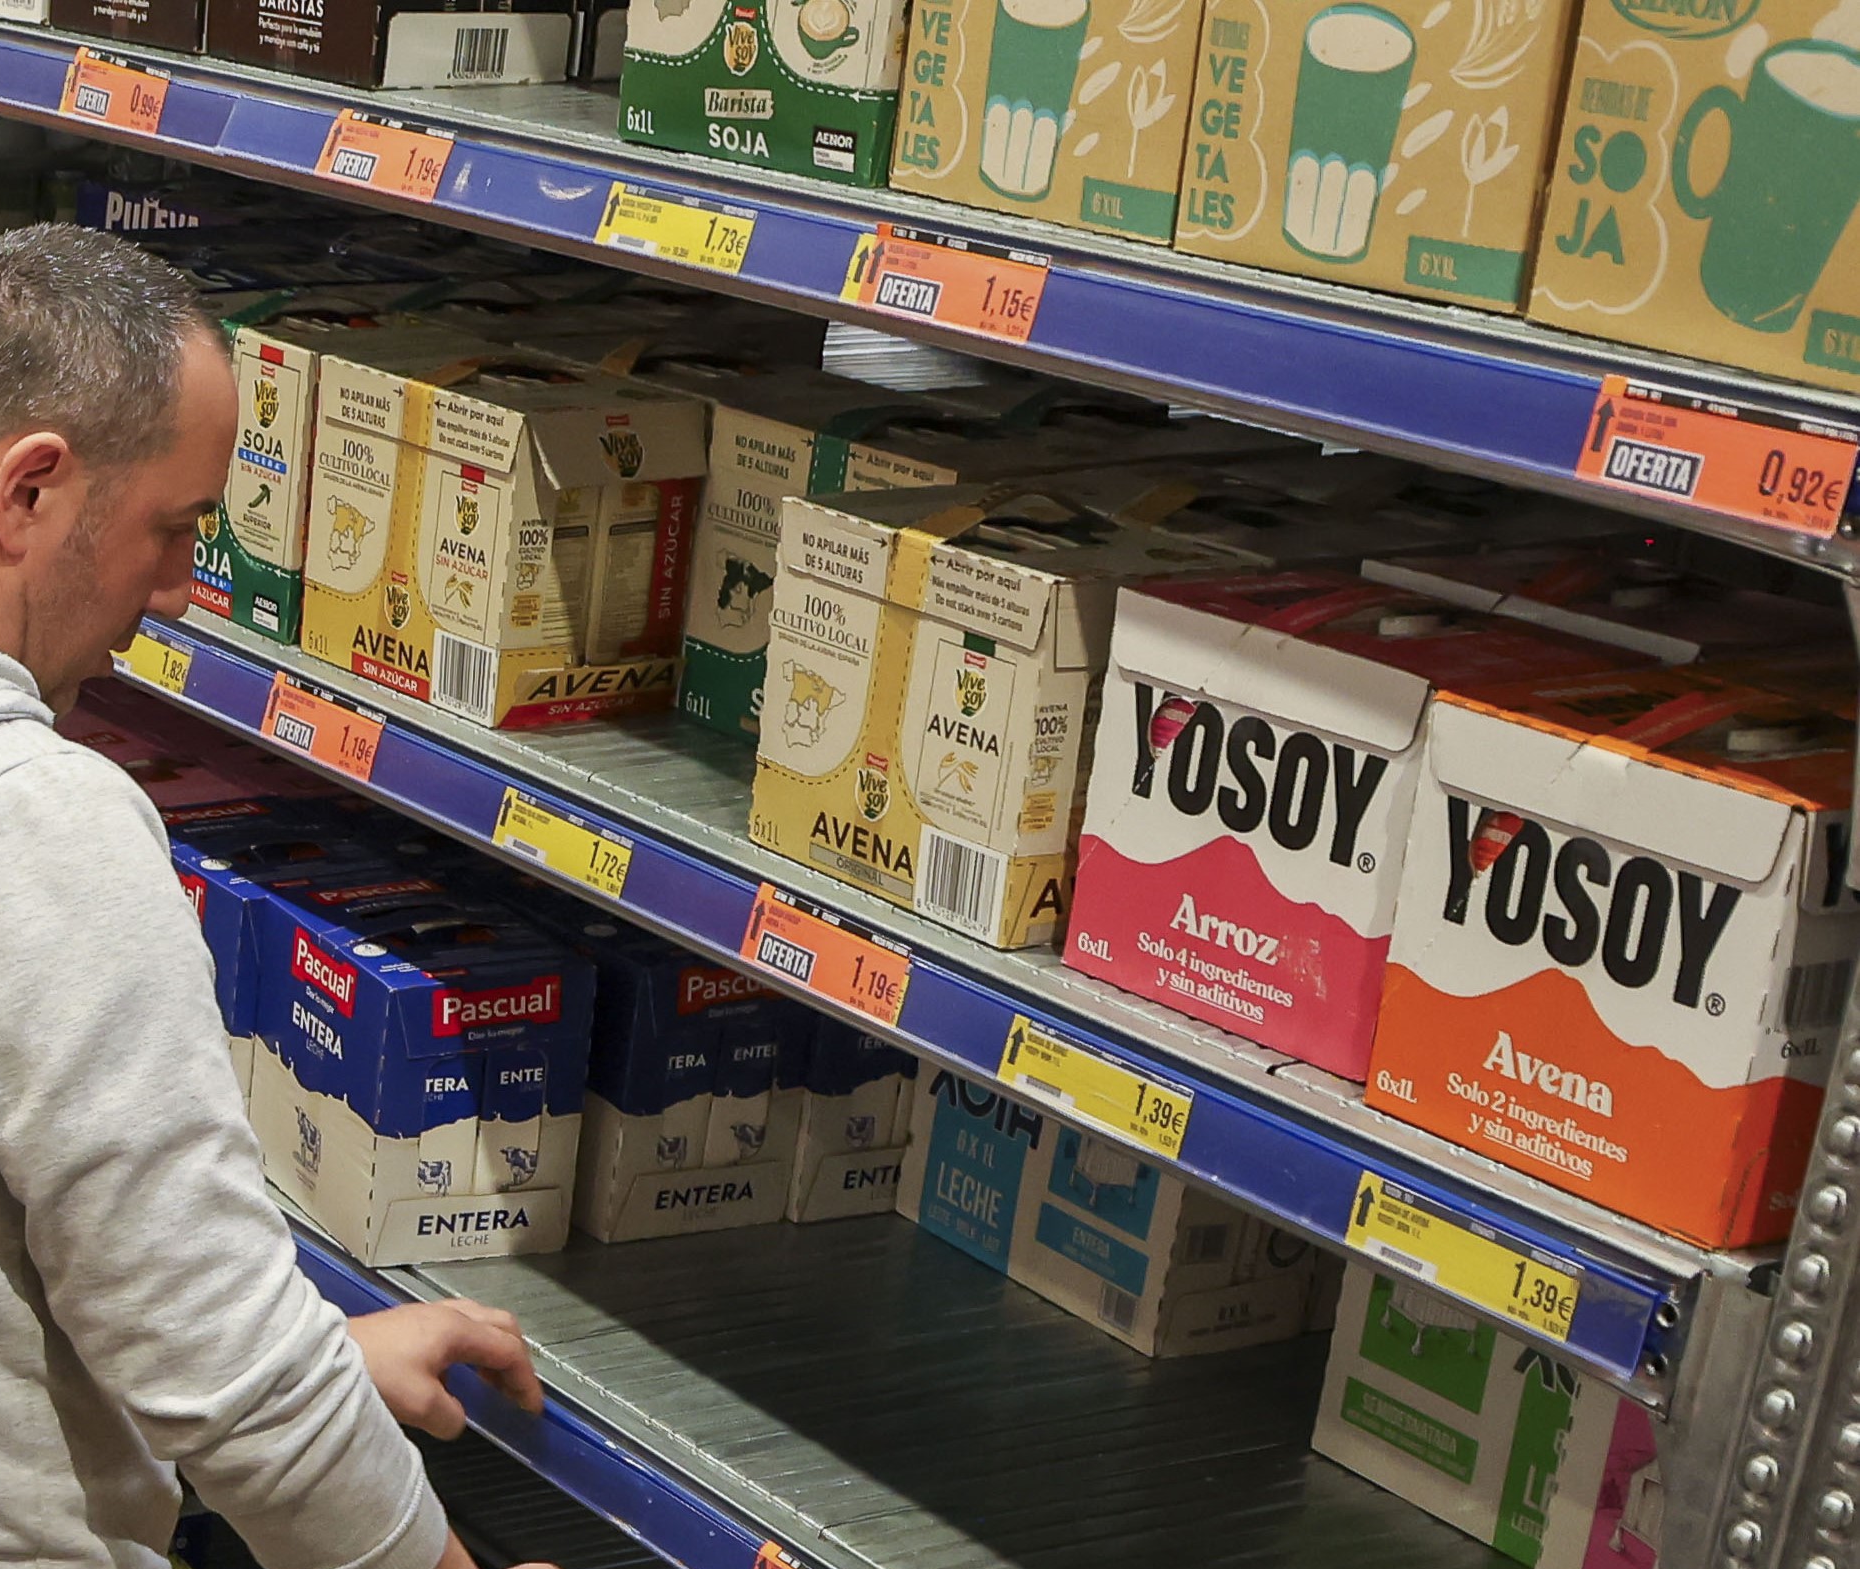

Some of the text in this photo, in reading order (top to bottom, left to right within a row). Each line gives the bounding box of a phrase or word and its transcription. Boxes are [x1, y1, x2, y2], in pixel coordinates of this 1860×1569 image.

[922, 9, 952, 46] VE
[913, 50, 947, 86] GE
[1210, 53, 1247, 94] VE
[76, 84, 161, 119] OFERTA 0,99€
[708, 91, 768, 114] Barista
[910, 90, 936, 127] TA
[1200, 98, 1242, 139] GE
[627, 107, 655, 135] 6x1L
[815, 131, 854, 148] AENOR
[708, 123, 769, 158] SOJA
[901, 131, 940, 169] LES
[1568, 125, 1648, 193] SO
[333, 147, 440, 184] OFERTA 1,19€
[1196, 144, 1229, 184] TA
[1188, 187, 1235, 230] LES
[704, 217, 745, 256] 1,73€
[1555, 198, 1626, 266] JA
[882, 275, 1035, 321] OFERTA 1,15€
[254, 379, 279, 402] Vive
[340, 386, 391, 411] NO APILAR MÁS
[242, 429, 285, 461] SOJA
[342, 438, 375, 465] 100%
[319, 451, 391, 487] CULTIVO LOCAL
[1612, 445, 1843, 511] OFERTA 0,92€
[455, 495, 479, 515] Vive
[439, 538, 487, 567] AVENA
[518, 530, 549, 547] 100%
[802, 531, 870, 566] NO APILAR MÁS
[658, 495, 683, 620] SIN AZÚCAR
[805, 553, 864, 584] DE 5 ALTURAS
[385, 585, 410, 608] Vive
[804, 593, 846, 626] 100%
[308, 630, 330, 656] 6x1L
[773, 607, 870, 654] CULTIVO LOCAL
[352, 624, 431, 678] AVENA
[362, 661, 419, 694] SIN AZÚCAR
[528, 662, 679, 702] AVENA
[955, 668, 986, 692] Vive
[964, 689, 987, 711] soy
[275, 714, 373, 767] OFERTA 1,19€
[927, 713, 1001, 757] AVENA
[1035, 715, 1067, 735] 100%
[859, 768, 888, 794] Vive
[1132, 681, 1389, 868] YOSOY
[866, 787, 890, 808] soy
[753, 814, 780, 846] 6x1L
[810, 811, 914, 878] AVENA
[591, 839, 627, 882] 1,72€
[835, 855, 884, 887] ORIGINAL
[1443, 794, 1742, 1009] YOSOY
[1170, 893, 1279, 966] Arroz
[296, 937, 354, 1002] Pascual
[761, 937, 897, 1004] OFERTA 1,19€
[1137, 931, 1294, 1008] Solo 4 ingredientes
[441, 994, 552, 1026] Pascual
[1156, 967, 1265, 1022] y sin aditivos
[292, 1001, 344, 1061] ENTERA
[305, 1038, 325, 1062] LECHE
[499, 1067, 544, 1085] ENTE
[1483, 1030, 1614, 1118] Avena
[1135, 1082, 1184, 1134] 1,39€
[1447, 1073, 1629, 1164] Solo 2 ingredientes
[1468, 1113, 1594, 1179] y sin aditivos
[655, 1180, 754, 1211] ENTERA
[937, 1161, 1004, 1230] LECHE
[417, 1206, 530, 1238] ENTERA
[450, 1234, 490, 1248] LECHE
[1513, 1260, 1574, 1323] 1,39€
